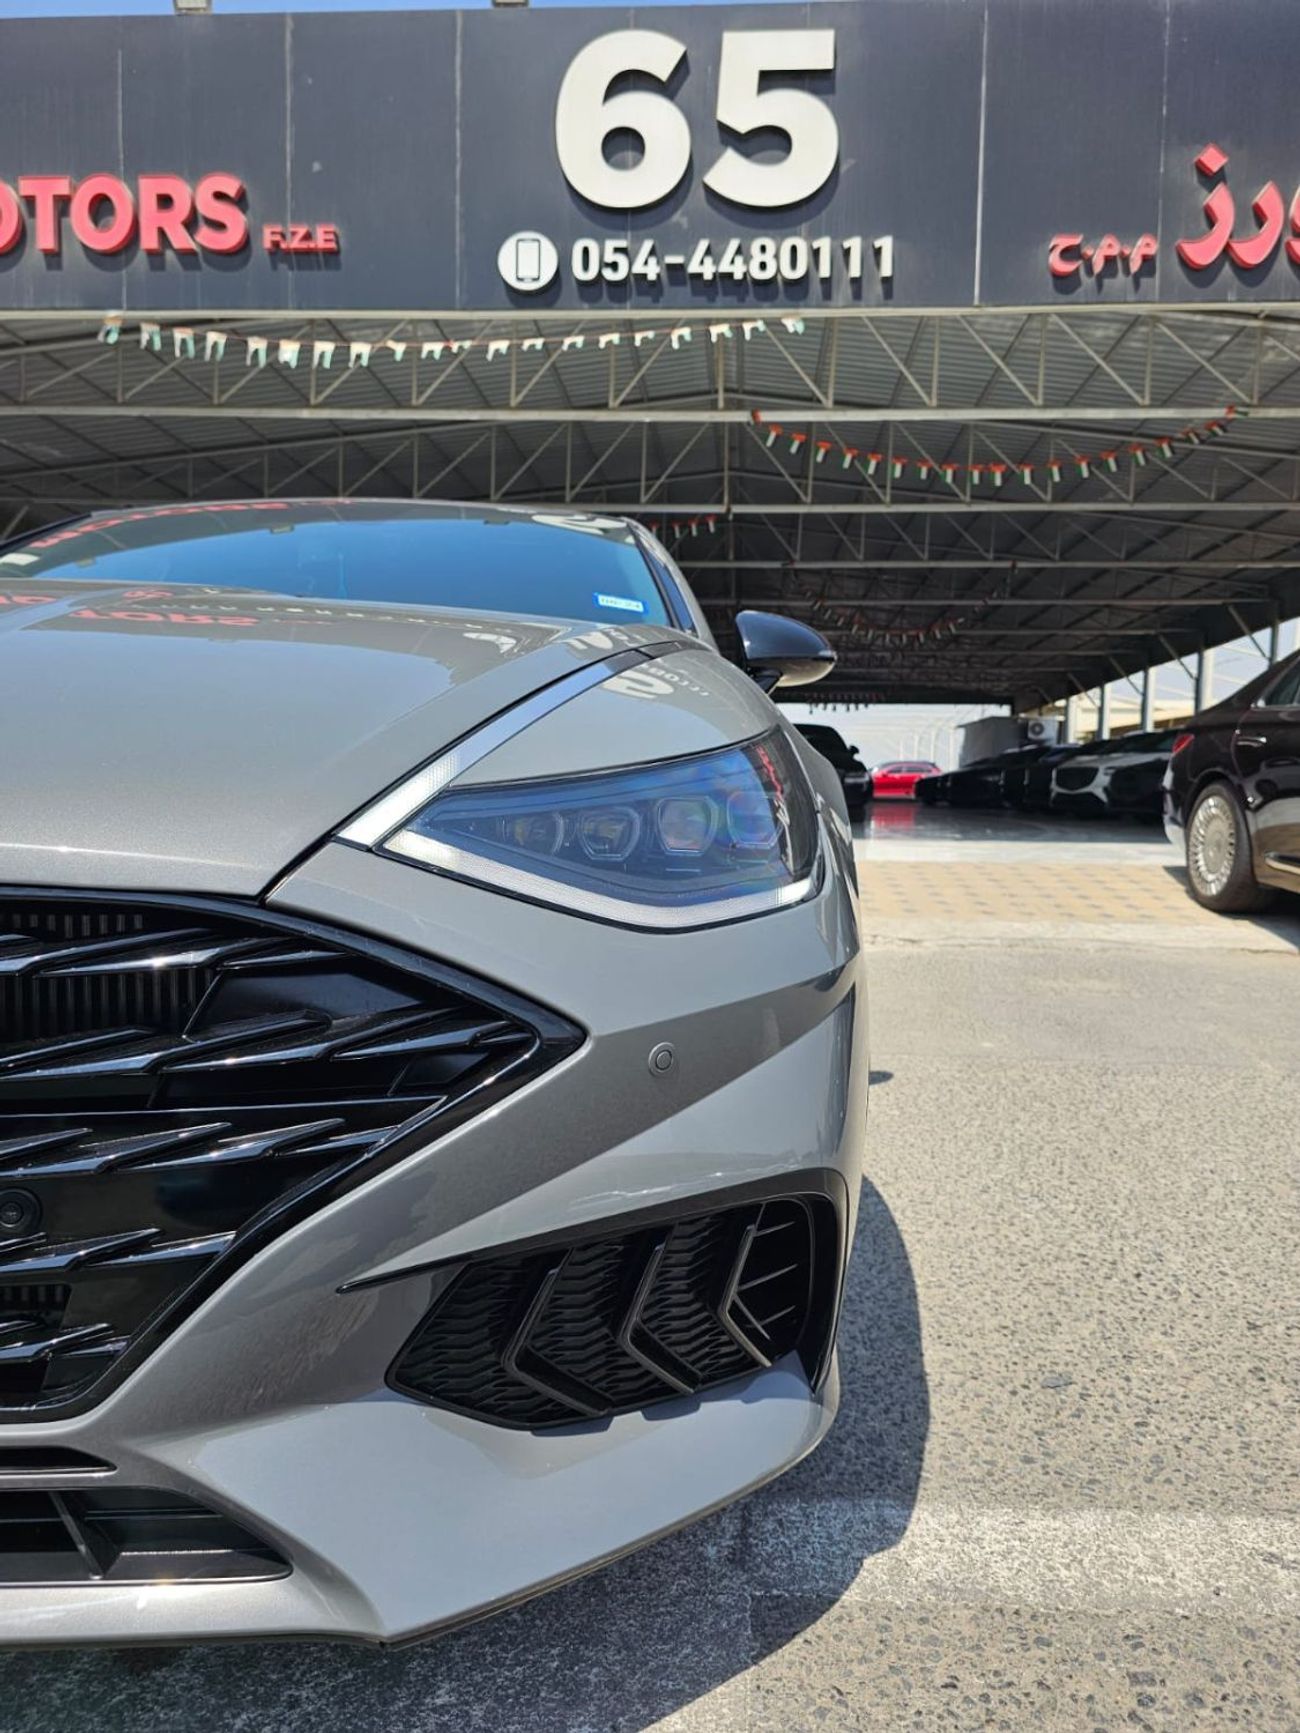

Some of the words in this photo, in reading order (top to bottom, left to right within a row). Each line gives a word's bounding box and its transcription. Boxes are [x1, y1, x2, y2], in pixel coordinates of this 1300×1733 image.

[555, 29, 839, 208] 65
[571, 235, 893, 282] 054-4480111
[1175, 142, 1300, 270] رز
